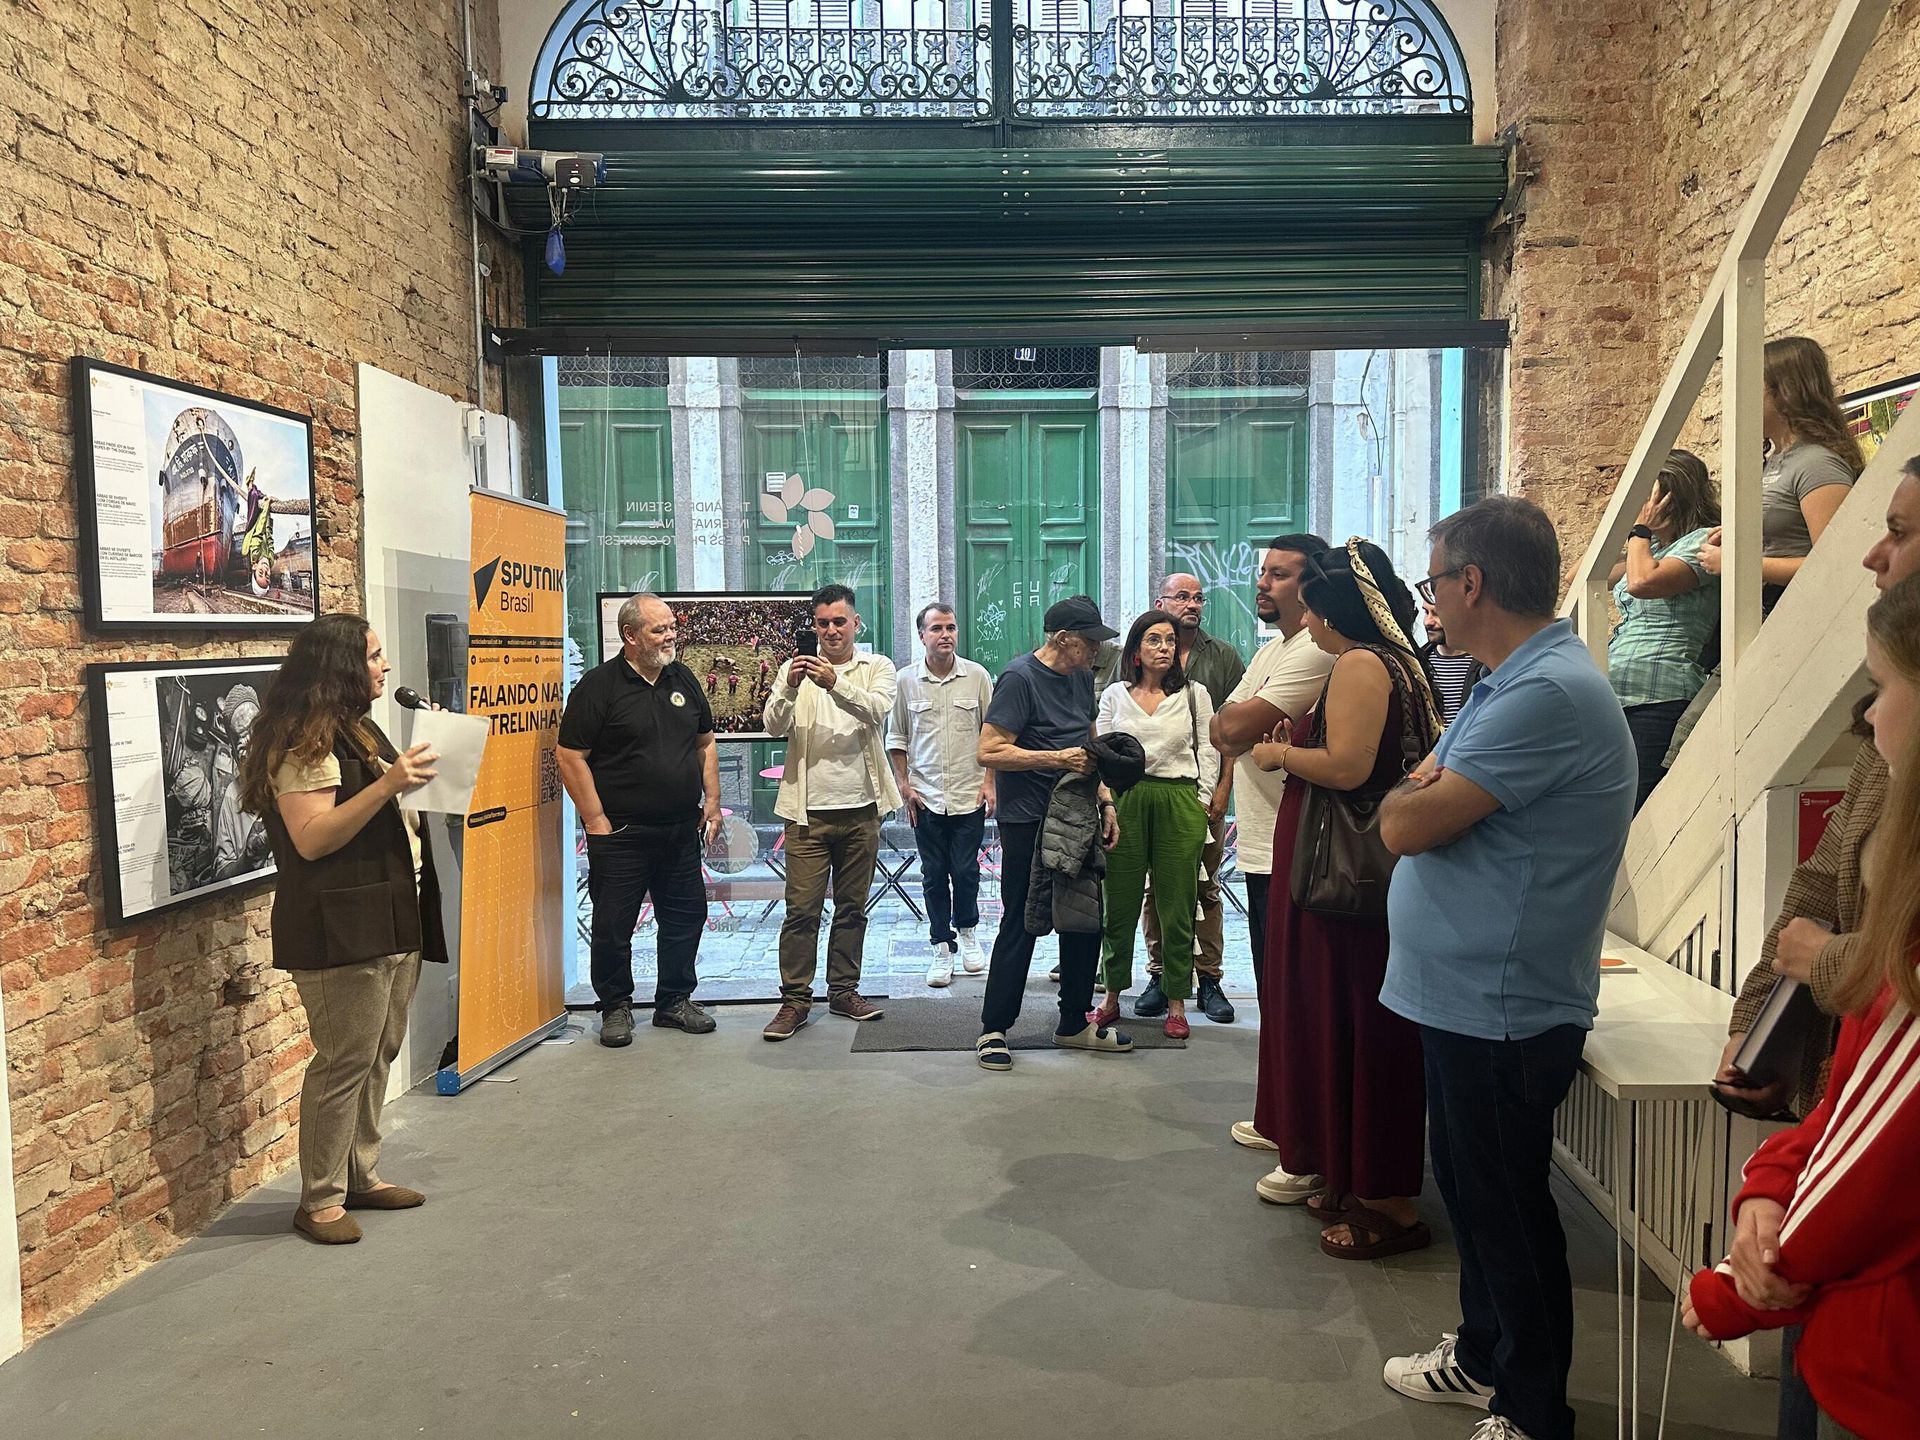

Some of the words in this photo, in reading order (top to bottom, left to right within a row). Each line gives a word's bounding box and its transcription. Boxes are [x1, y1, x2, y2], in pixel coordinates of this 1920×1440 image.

[1020, 348, 1030, 360] 10
[501, 560, 564, 592] SPUTNIK
[501, 591, 534, 613] Brasil
[470, 683, 538, 708] FALANDO
